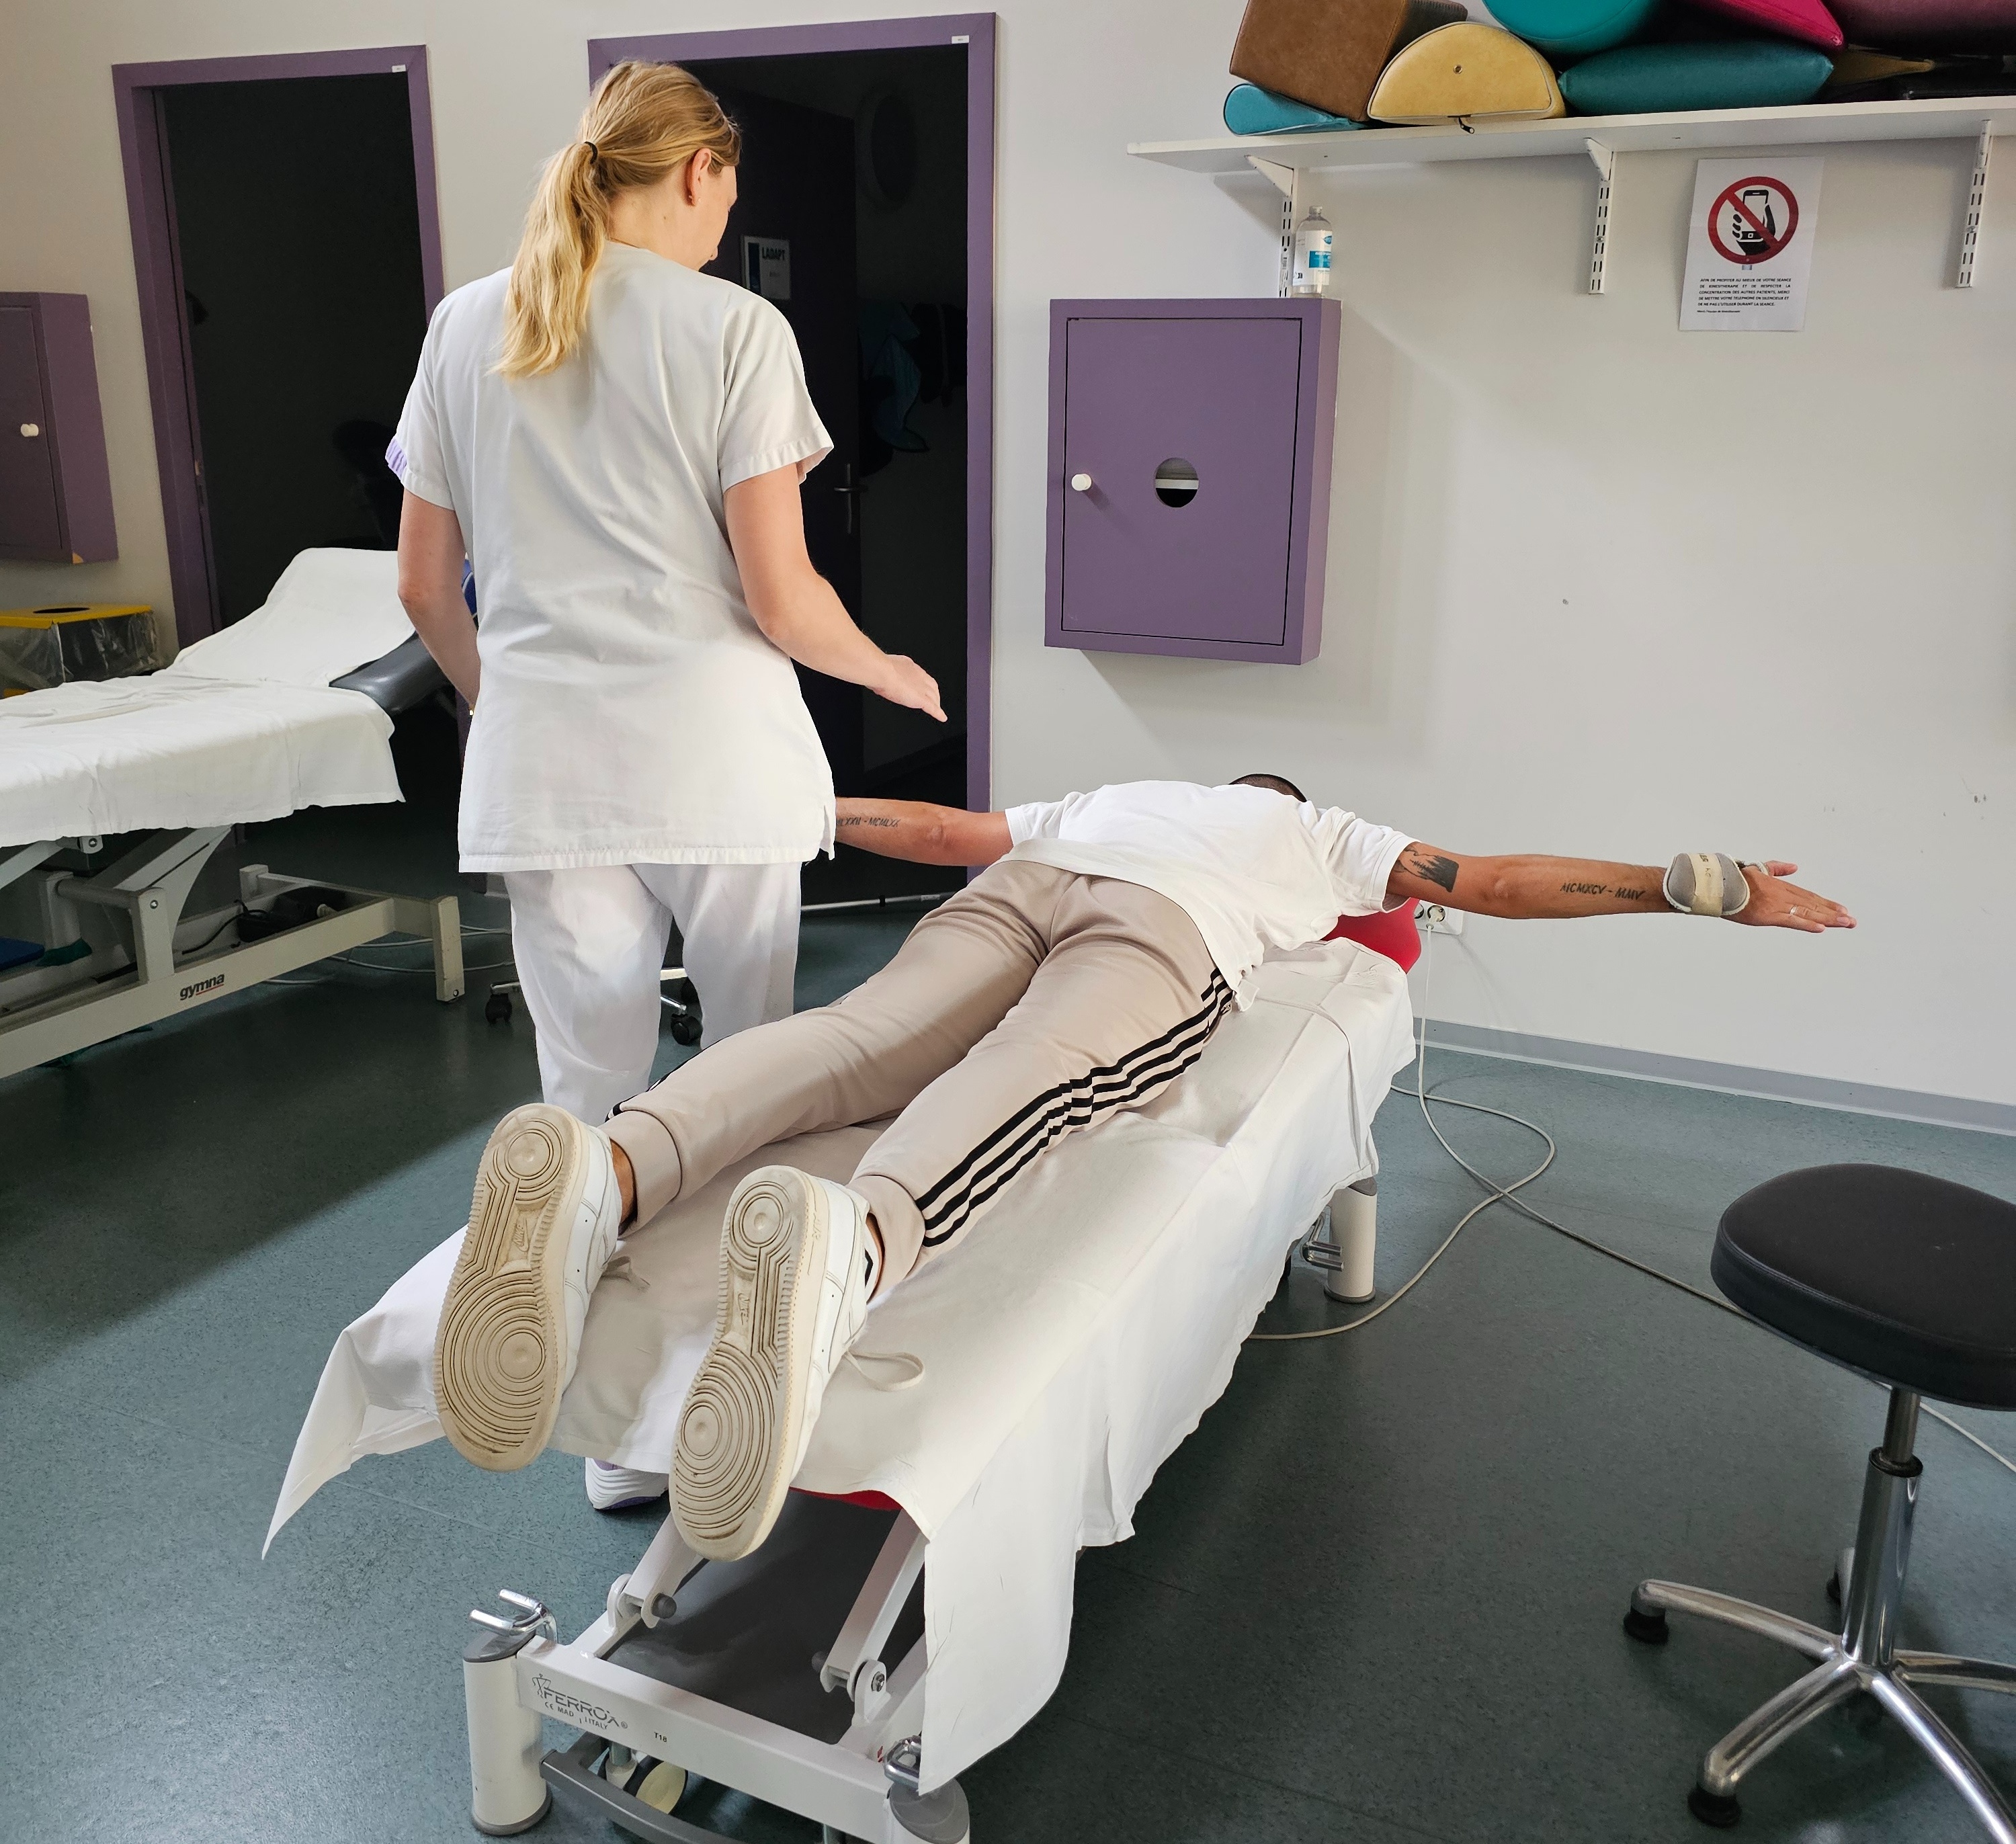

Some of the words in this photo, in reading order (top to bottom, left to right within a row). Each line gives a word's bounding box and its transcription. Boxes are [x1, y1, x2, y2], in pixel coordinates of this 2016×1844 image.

[179, 974, 225, 1001] gymna
[588, 1718, 609, 1730] ITALY
[653, 1731, 668, 1743] T18
